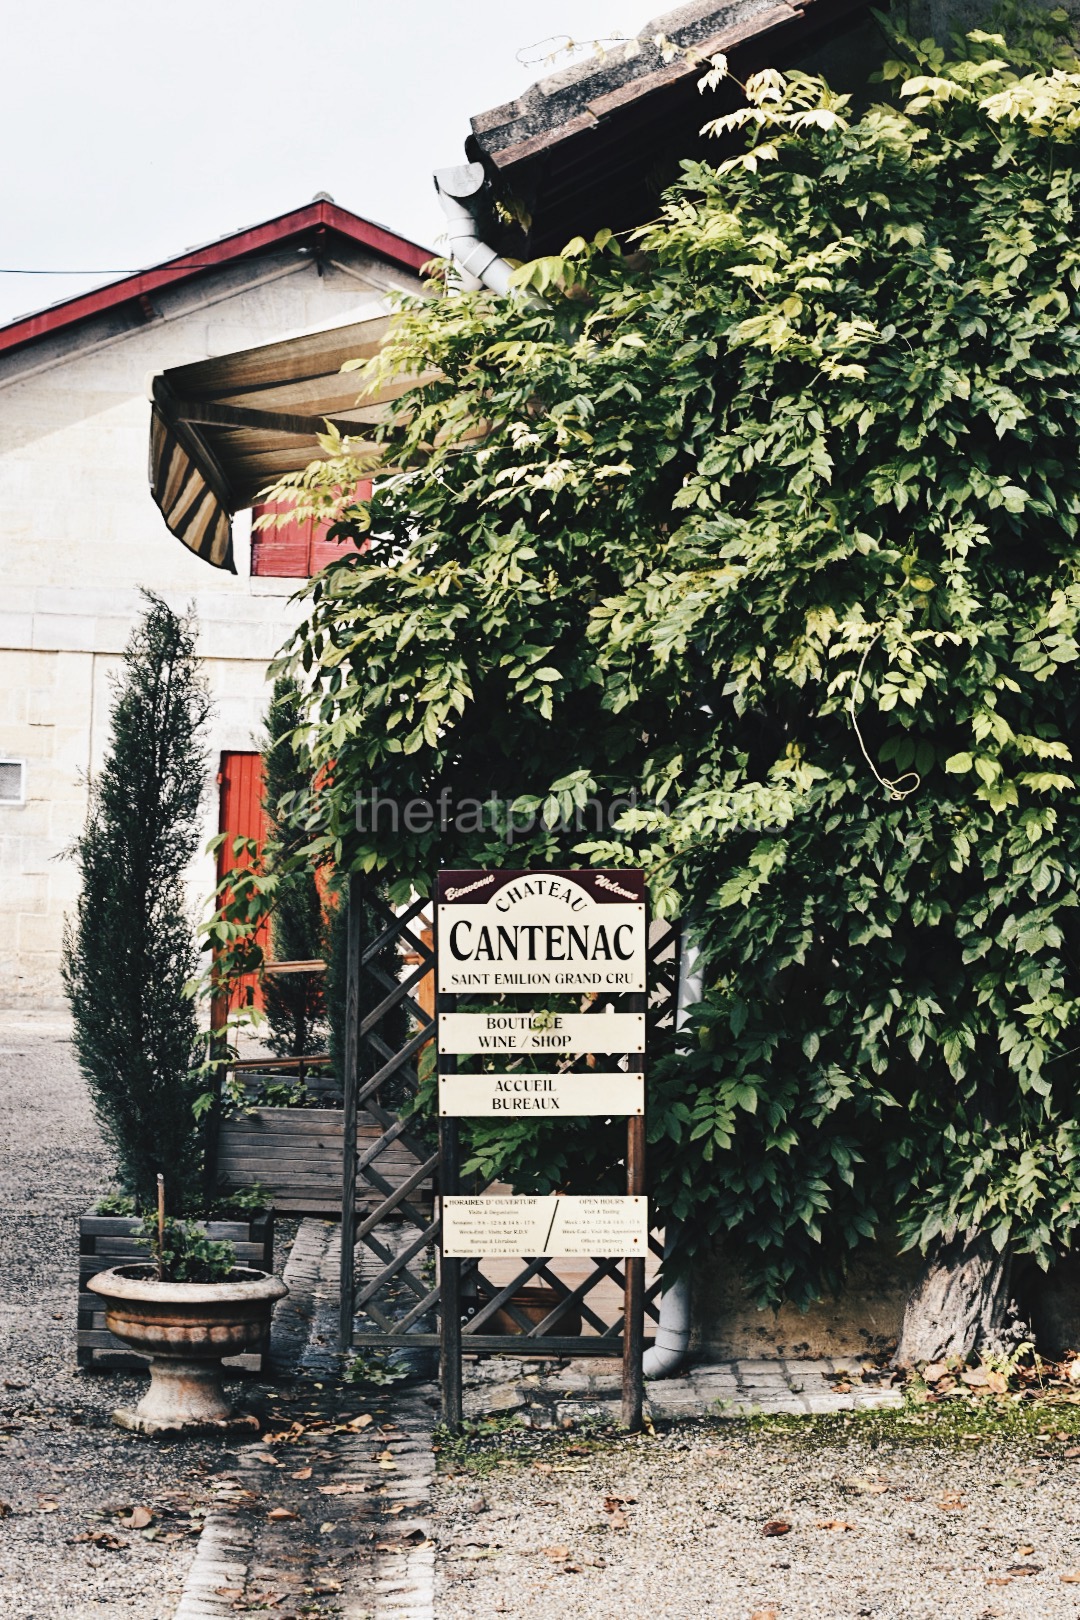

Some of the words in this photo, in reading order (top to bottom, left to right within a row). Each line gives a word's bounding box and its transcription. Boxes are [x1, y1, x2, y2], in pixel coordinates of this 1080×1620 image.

[444, 874, 496, 901] Bienvenue
[594, 874, 640, 900] Welcome
[495, 880, 588, 913] CHATEAU
[449, 920, 635, 962] CANTENAC
[451, 973, 490, 985] SAINT
[494, 973, 551, 985] EMILION
[555, 972, 602, 984] GRAND
[606, 972, 634, 984] CRU
[486, 1017, 563, 1030] BOUTIE
[478, 1036, 517, 1048] WINE
[532, 1036, 572, 1048] SHOP
[494, 1080, 558, 1092] ACCUEIL
[492, 1098, 560, 1110] BUREAUX
